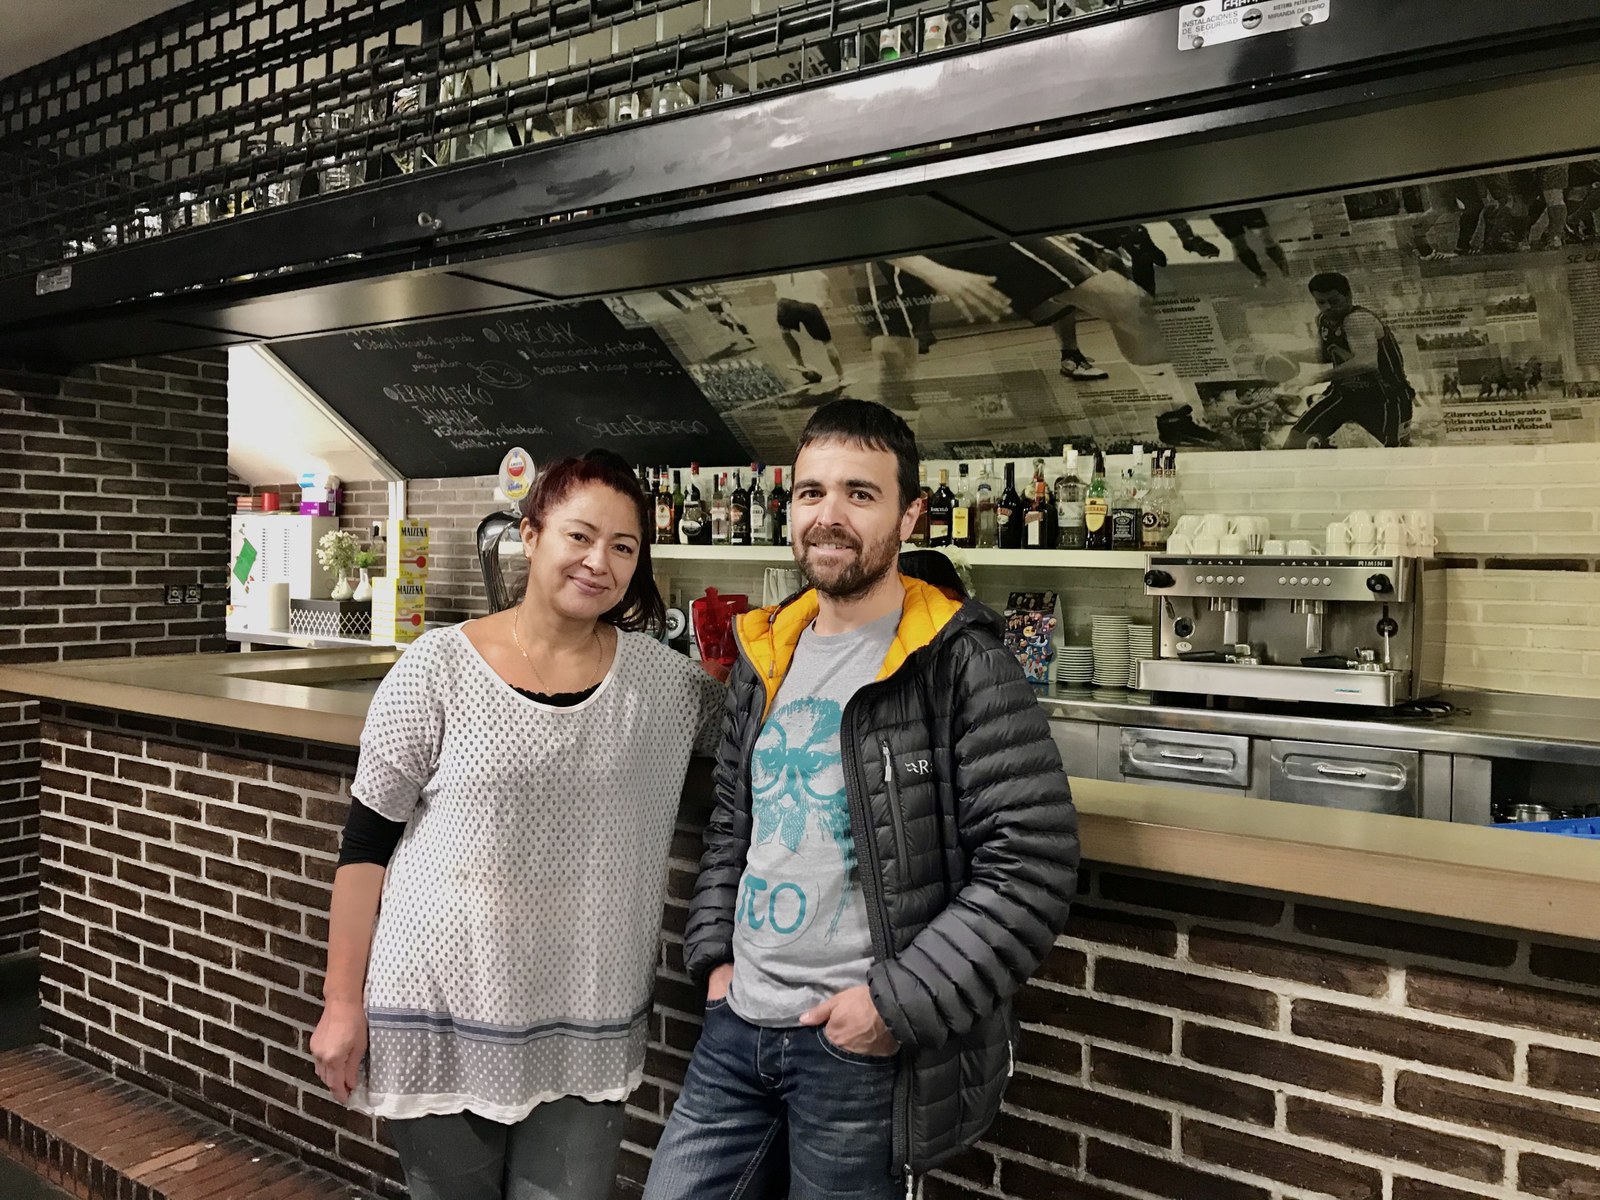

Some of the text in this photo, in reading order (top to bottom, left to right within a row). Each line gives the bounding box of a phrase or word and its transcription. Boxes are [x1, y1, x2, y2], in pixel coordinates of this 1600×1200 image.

[1267, 11, 1296, 20] MIRANDA
[1307, 3, 1326, 12] EBRO
[1182, 10, 1238, 27] INSTALACIONES
[1195, 18, 1239, 31] SEGURIDAD
[1443, 408, 1547, 419] Zilarrezko Ligarako
[1517, 416, 1543, 424] gora
[1469, 424, 1491, 432] zaio
[1492, 423, 1512, 431] Lan
[1514, 422, 1553, 431] Mobeli
[1142, 515, 1154, 525] 43
[401, 526, 428, 537] MAIZENA
[397, 584, 424, 595] MAIZENA
